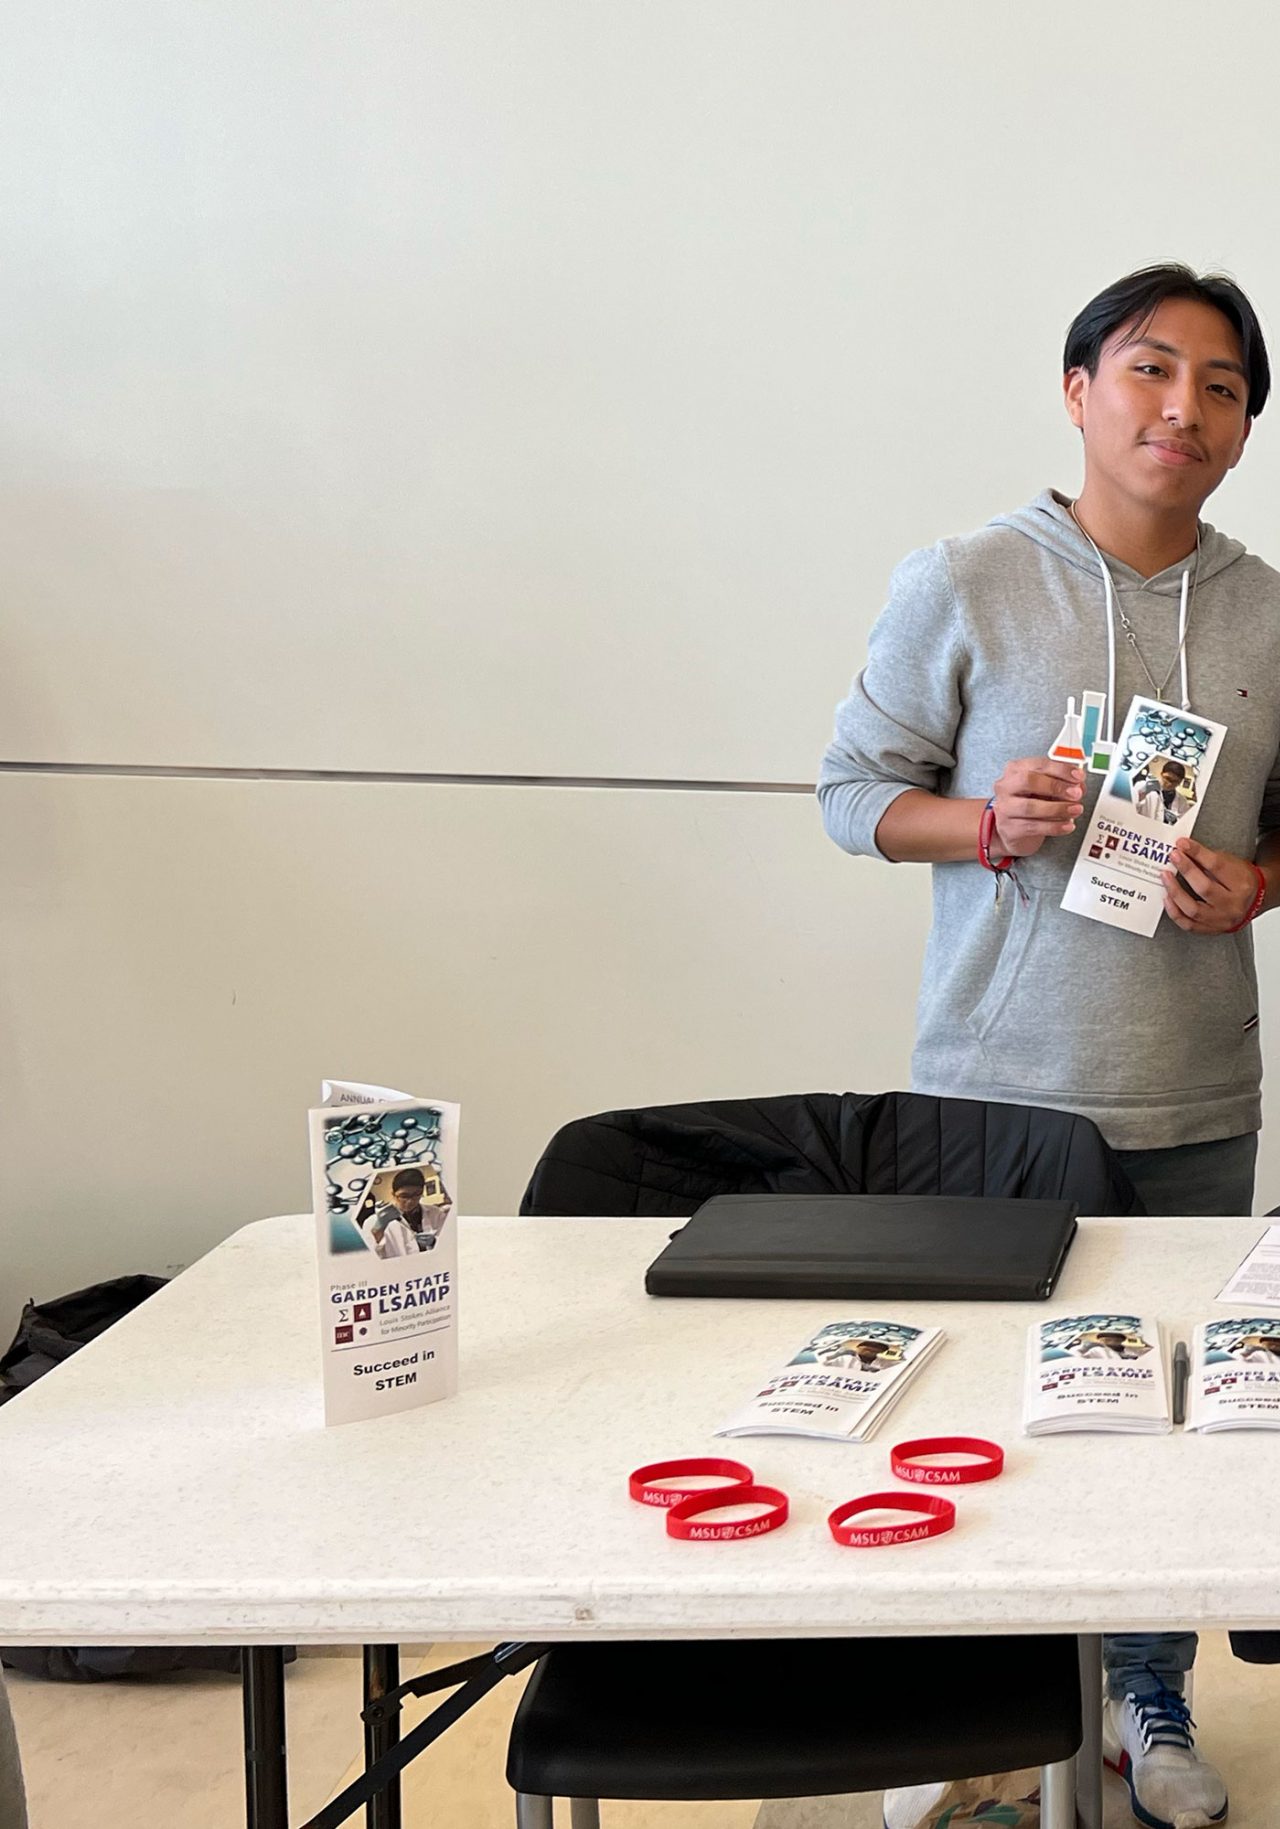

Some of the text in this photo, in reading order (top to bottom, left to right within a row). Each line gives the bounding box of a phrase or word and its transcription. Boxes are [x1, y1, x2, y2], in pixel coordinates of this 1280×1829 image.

[1097, 821, 1142, 842] GARDEN
[1090, 876, 1147, 902] Succeed in
[1099, 894, 1131, 911] STEM
[330, 1282, 356, 1291] Phase
[331, 1271, 450, 1304] GARDEN STATE
[379, 1285, 450, 1314] LSAMP
[391, 1322, 416, 1334] Minority
[353, 1350, 435, 1376] Succeed in
[375, 1372, 417, 1391] STEM
[835, 1376, 882, 1387] STATE
[1082, 1371, 1154, 1379] LSAMP
[804, 1379, 878, 1393] LSAMP
[771, 1407, 815, 1415] STEM
[895, 1465, 961, 1482] MSU CSAM
[642, 1490, 671, 1506] MSU
[689, 1518, 771, 1540] MSU CSAM
[850, 1525, 930, 1546] MSU CSAM
